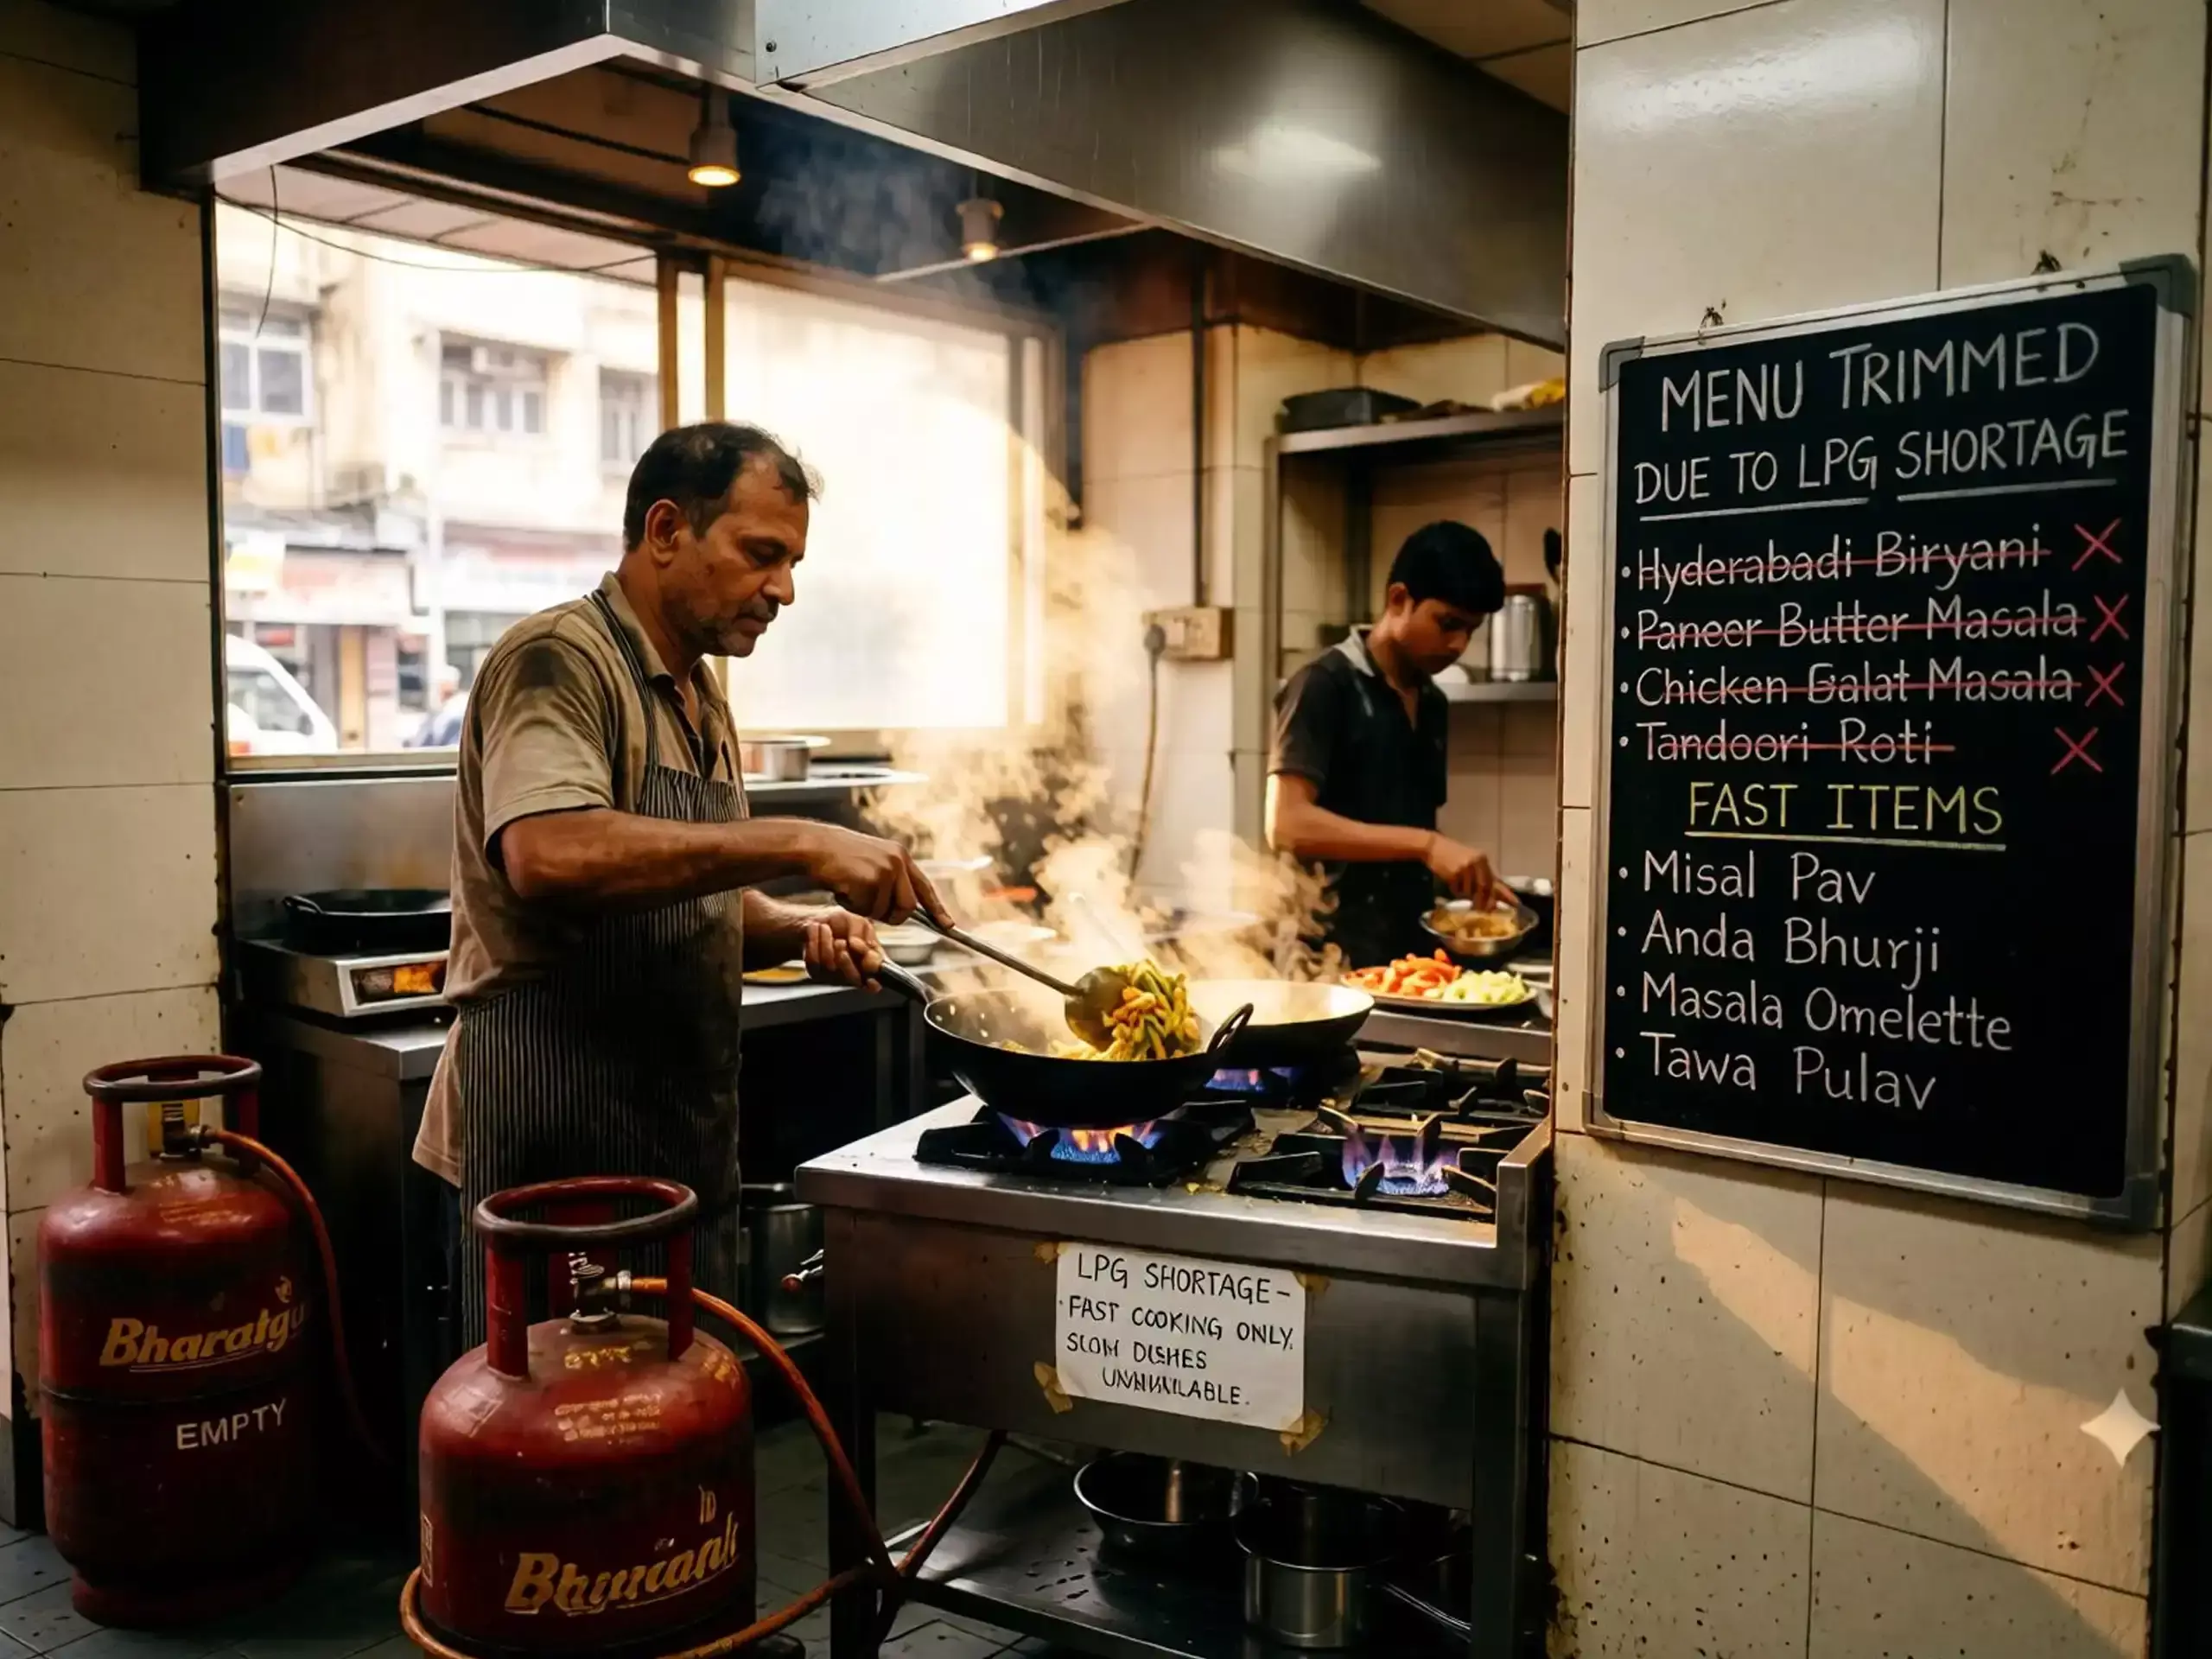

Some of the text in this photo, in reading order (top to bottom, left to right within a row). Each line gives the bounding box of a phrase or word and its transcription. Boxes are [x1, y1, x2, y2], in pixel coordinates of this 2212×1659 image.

[1661, 321, 2100, 433] MENU TRIMMED
[1634, 409, 2129, 505] DUE TO LPG SHORTAGE
[1637, 522, 2042, 605] Hyderabadi Biryani
[1637, 588, 2079, 652] Paneer Butter Masala
[1636, 665, 1788, 708] Chicken
[1927, 654, 2074, 702] Masala
[1636, 716, 1934, 766] Tandoori Roti
[1688, 779, 2003, 835] FAST ITEMS
[1643, 849, 1877, 905] Misal Pav
[1640, 907, 1941, 991] Anda Bhurji
[1640, 969, 2013, 1052] Masala Omelette
[1638, 1030, 1937, 1111] Tawa Pulav
[1077, 1252, 1128, 1289] LPG
[1068, 1294, 1120, 1323] FAST
[1131, 1306, 1224, 1341] COOKING
[1132, 1340, 1208, 1370] DISHES
[175, 1397, 288, 1451] EMPTY
